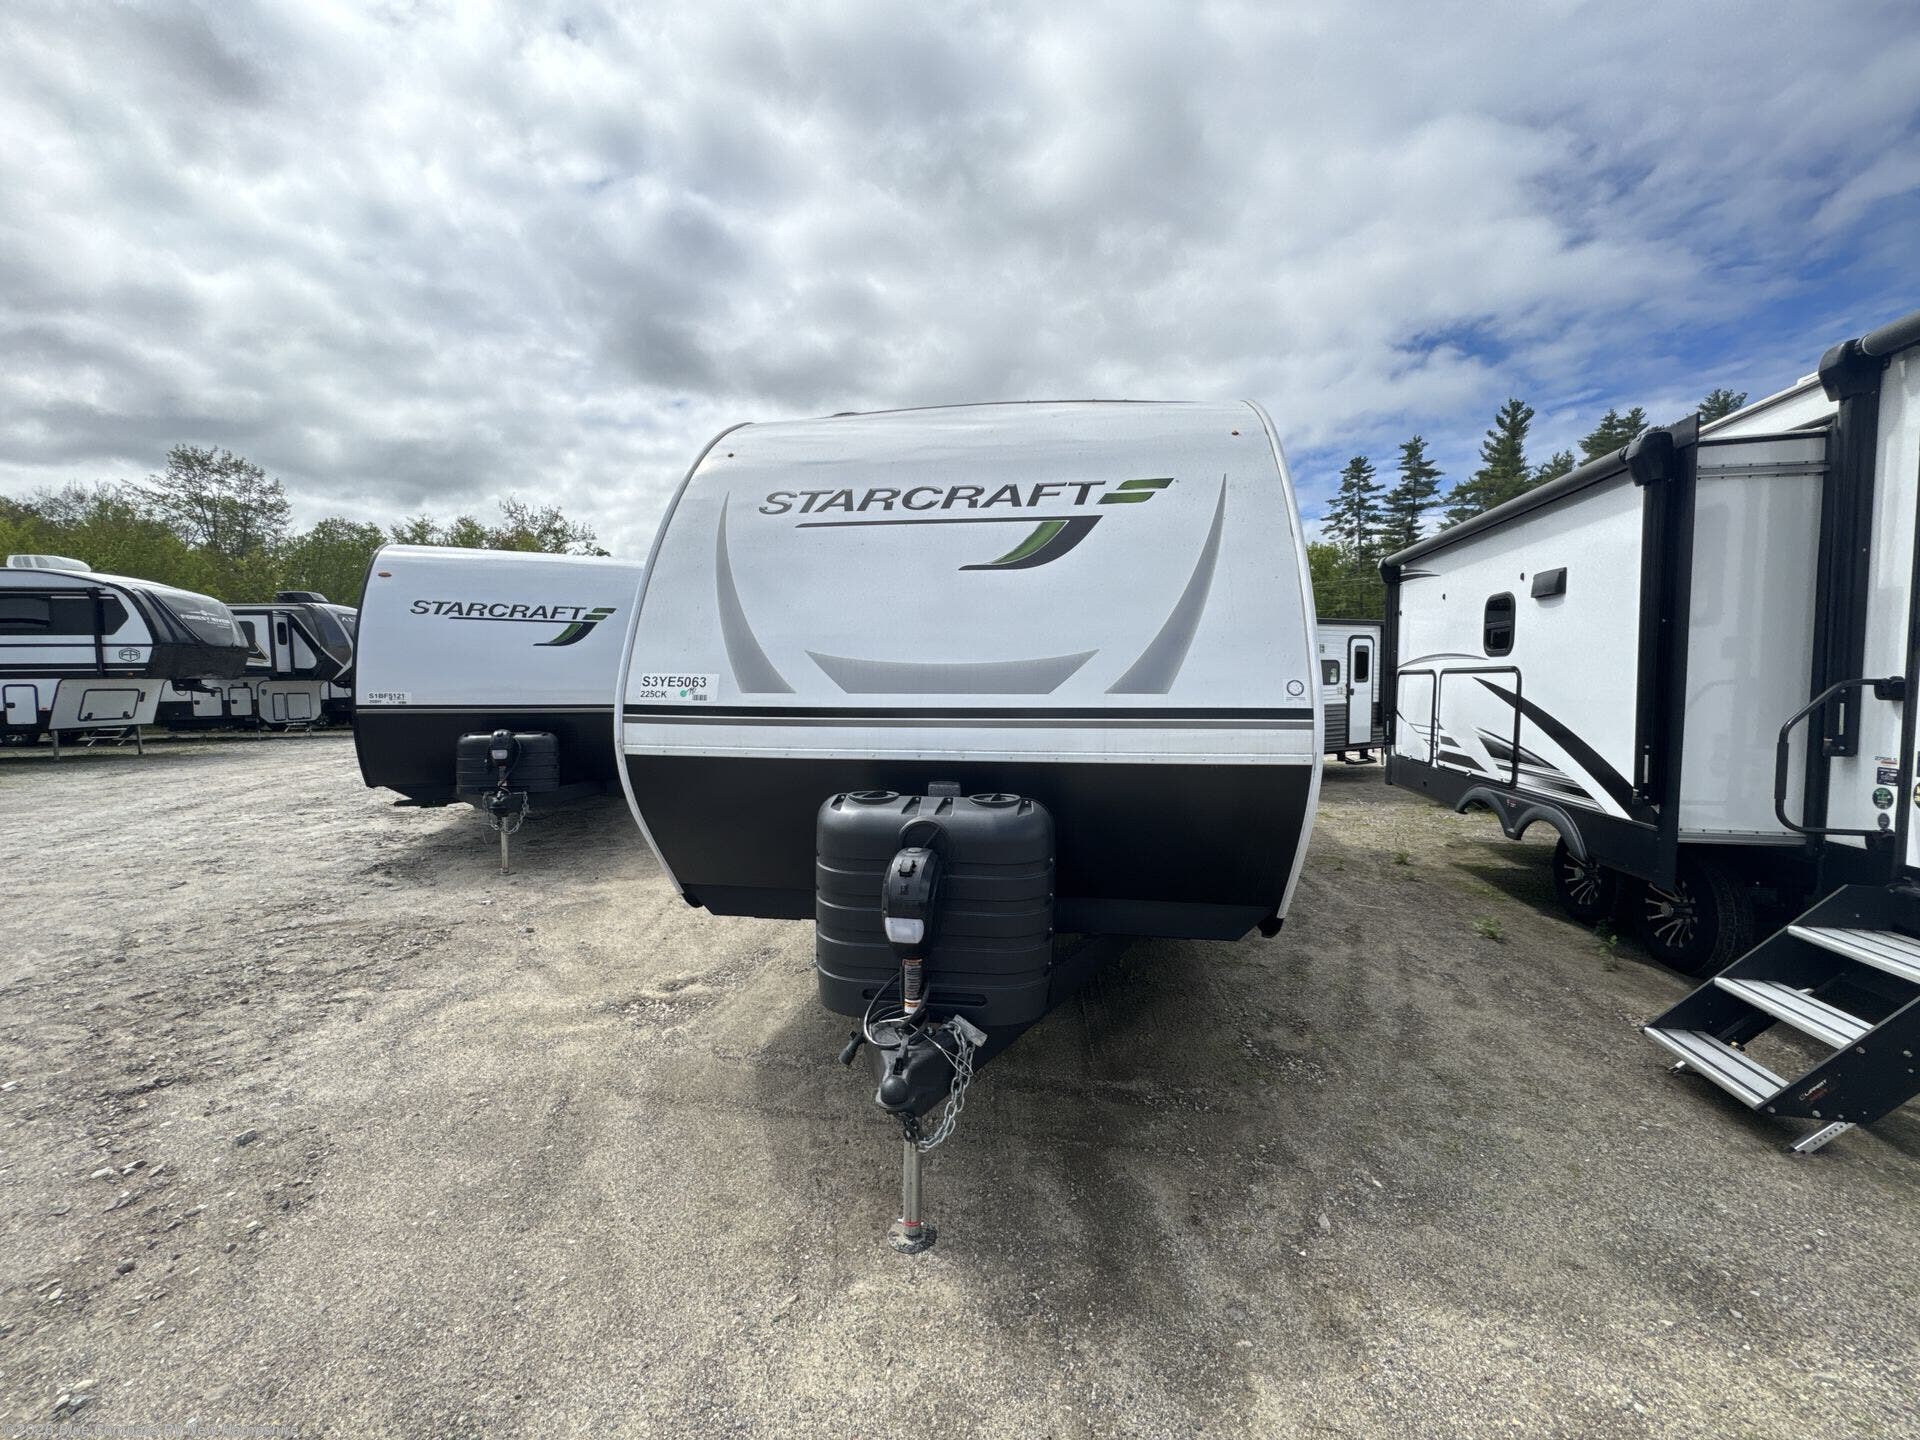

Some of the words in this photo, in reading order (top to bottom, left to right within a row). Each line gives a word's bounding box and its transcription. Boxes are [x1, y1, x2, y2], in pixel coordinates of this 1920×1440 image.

[759, 480, 1106, 515] STARCRAFT
[410, 599, 587, 620] STARCRAFT
[641, 675, 707, 688] S3YE5063
[640, 690, 667, 698] 225CK
